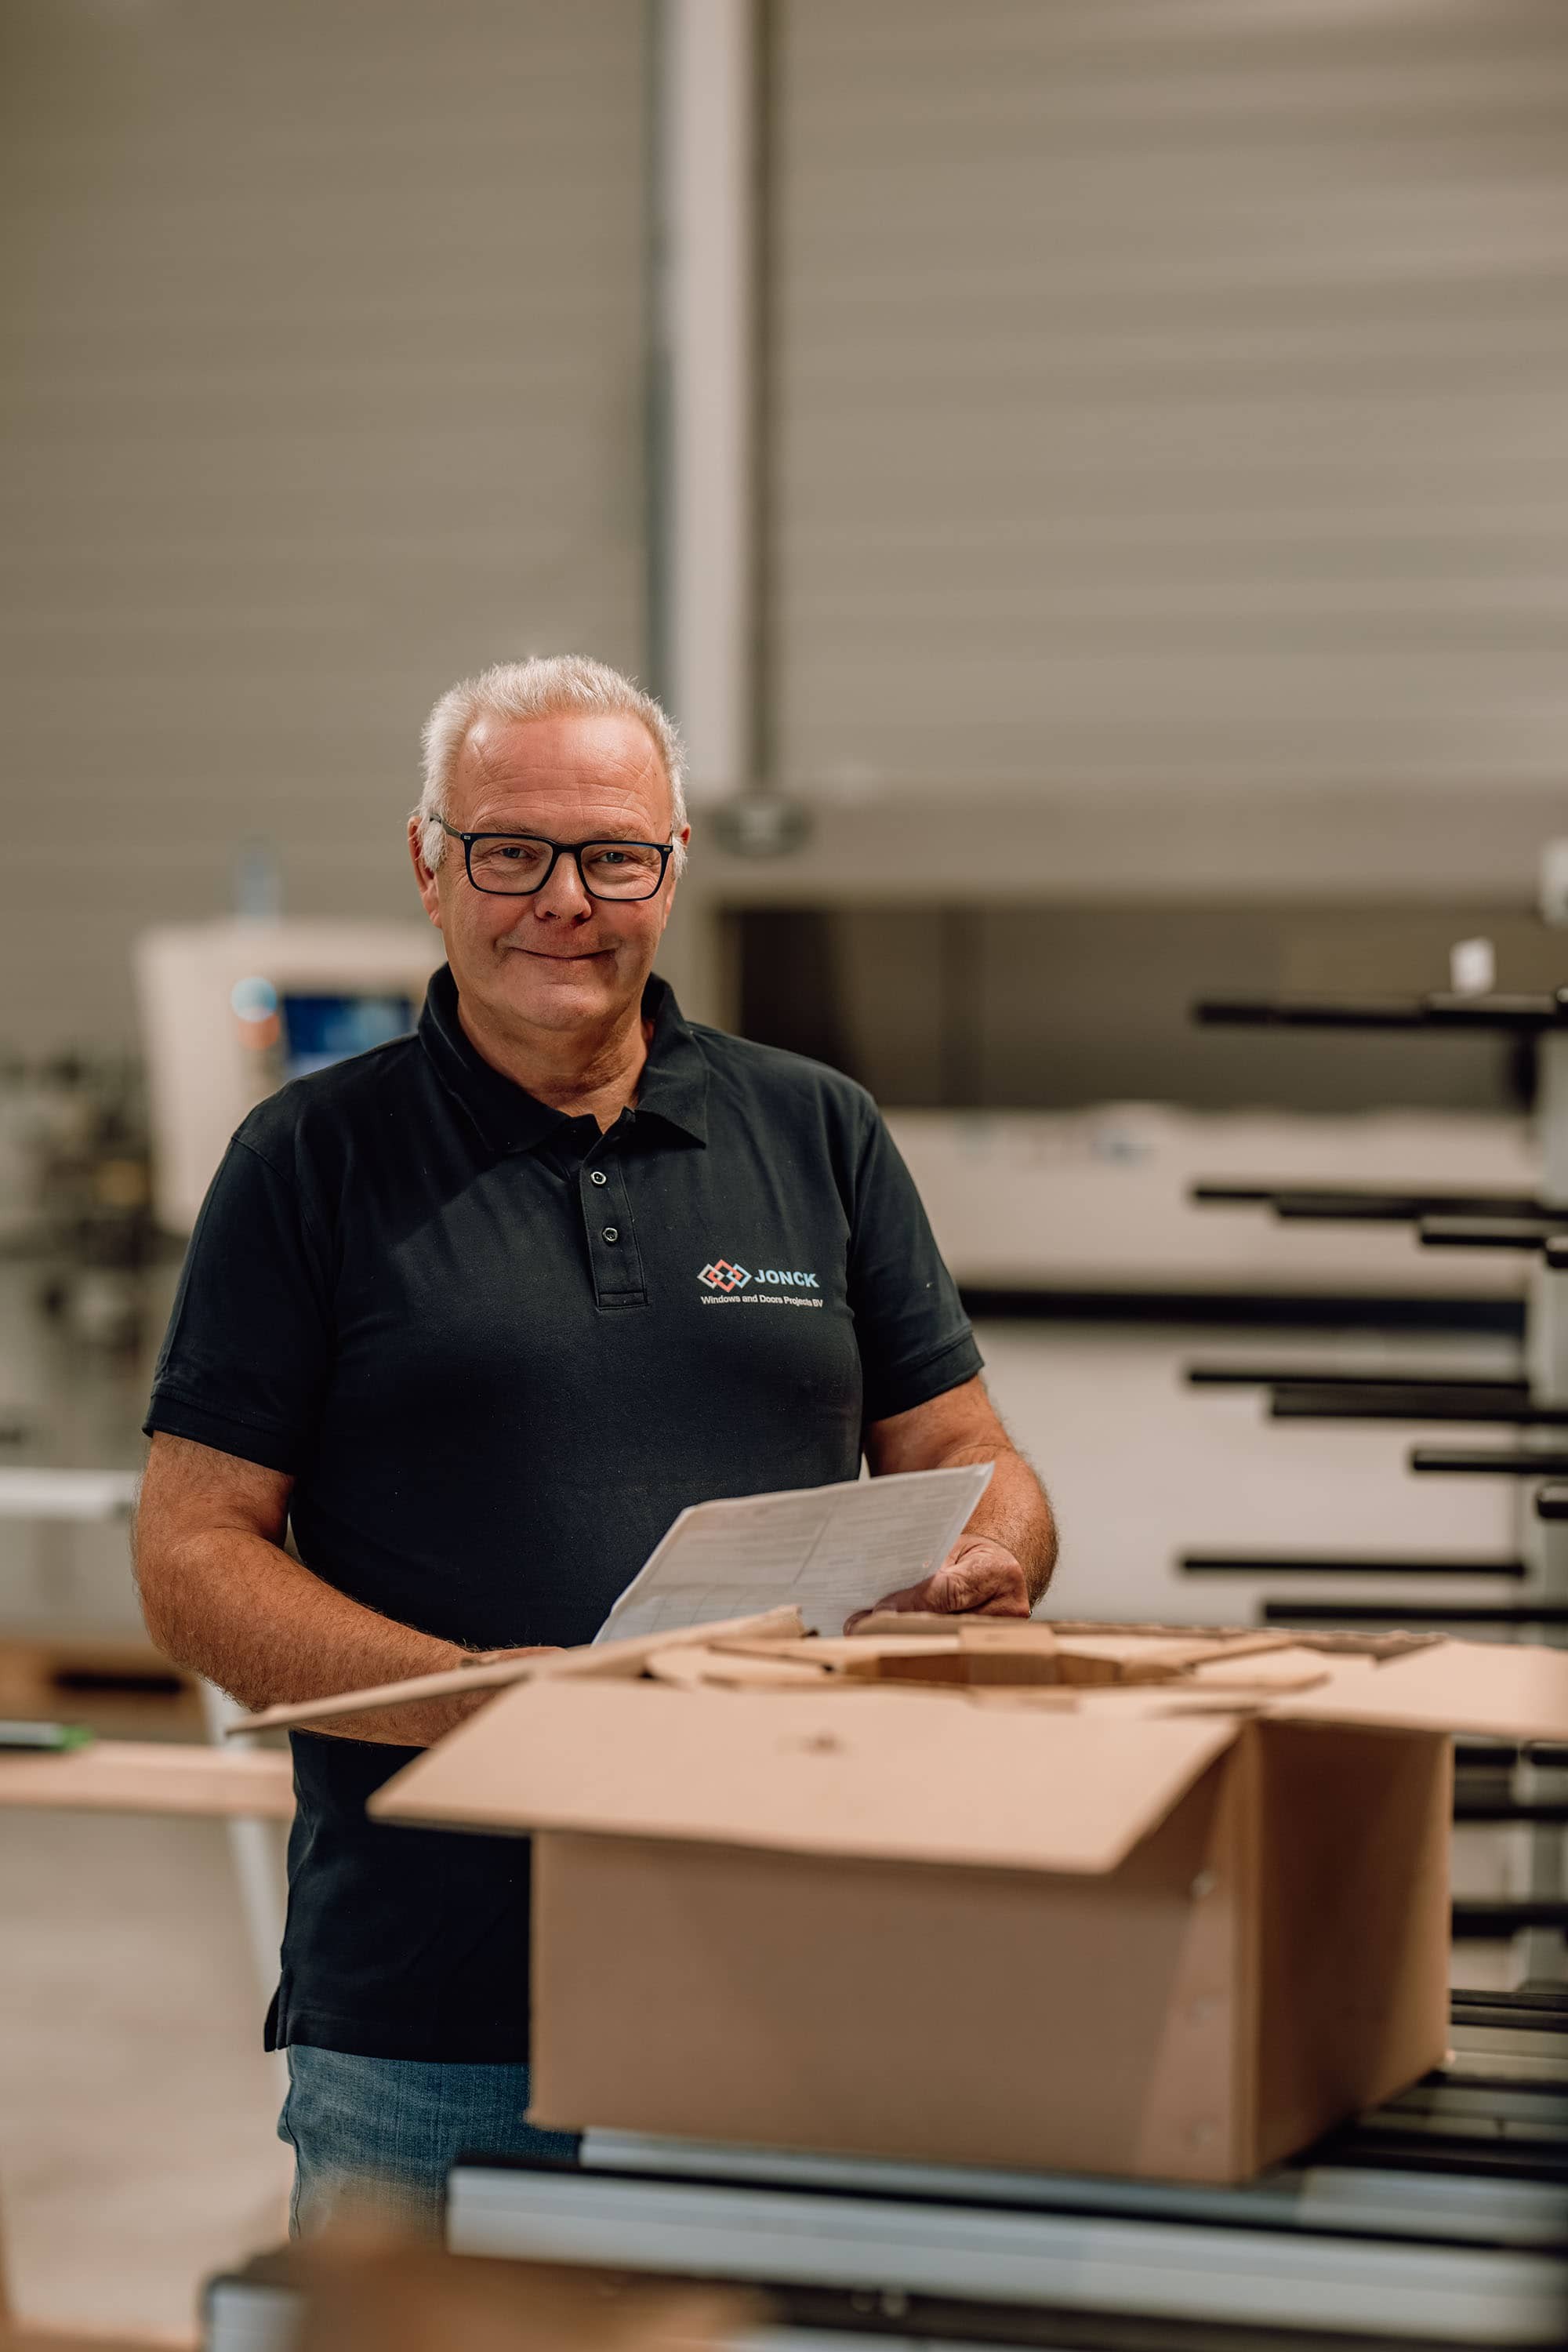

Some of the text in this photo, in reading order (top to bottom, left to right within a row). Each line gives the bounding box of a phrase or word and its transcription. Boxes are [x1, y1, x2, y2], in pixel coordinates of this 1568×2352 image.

[754, 1269, 820, 1287] JONCK
[700, 1294, 823, 1308] Windows and Doors Projects BV
